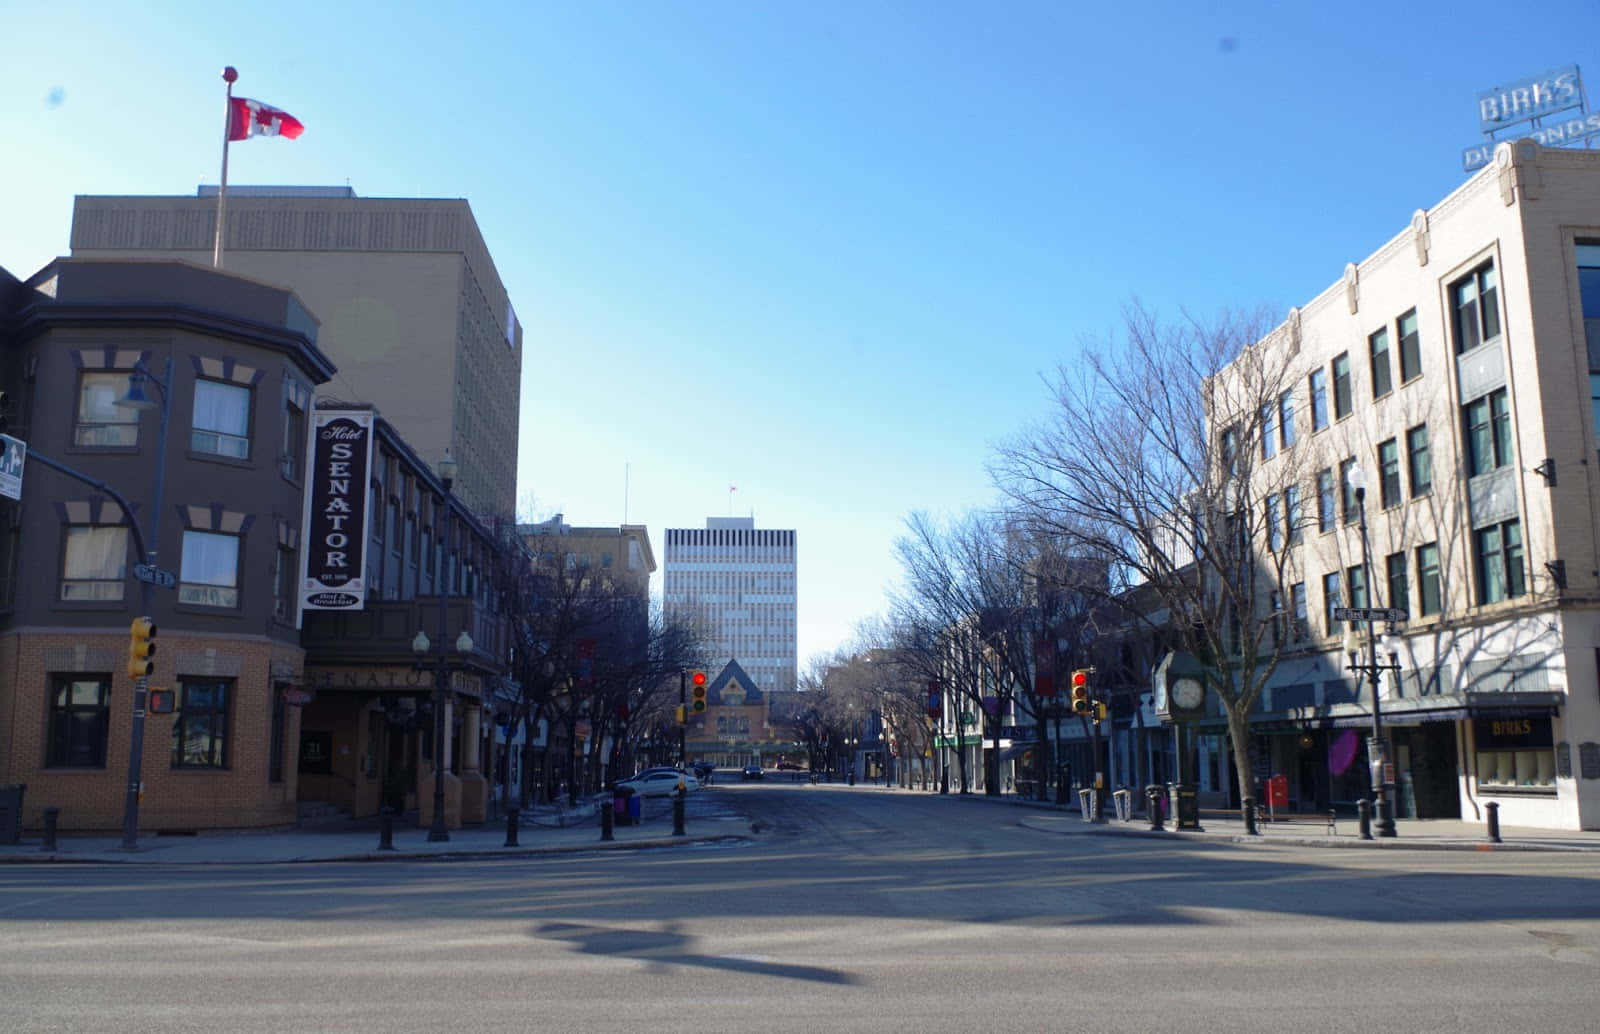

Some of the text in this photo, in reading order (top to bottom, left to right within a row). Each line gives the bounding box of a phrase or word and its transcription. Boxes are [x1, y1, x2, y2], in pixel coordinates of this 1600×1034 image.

[1480, 73, 1577, 121] BIRKS
[1465, 115, 1600, 167] DIONDS
[320, 426, 363, 441] Hotel
[325, 443, 353, 568] SENATOR
[1491, 720, 1532, 736] BIRKS
